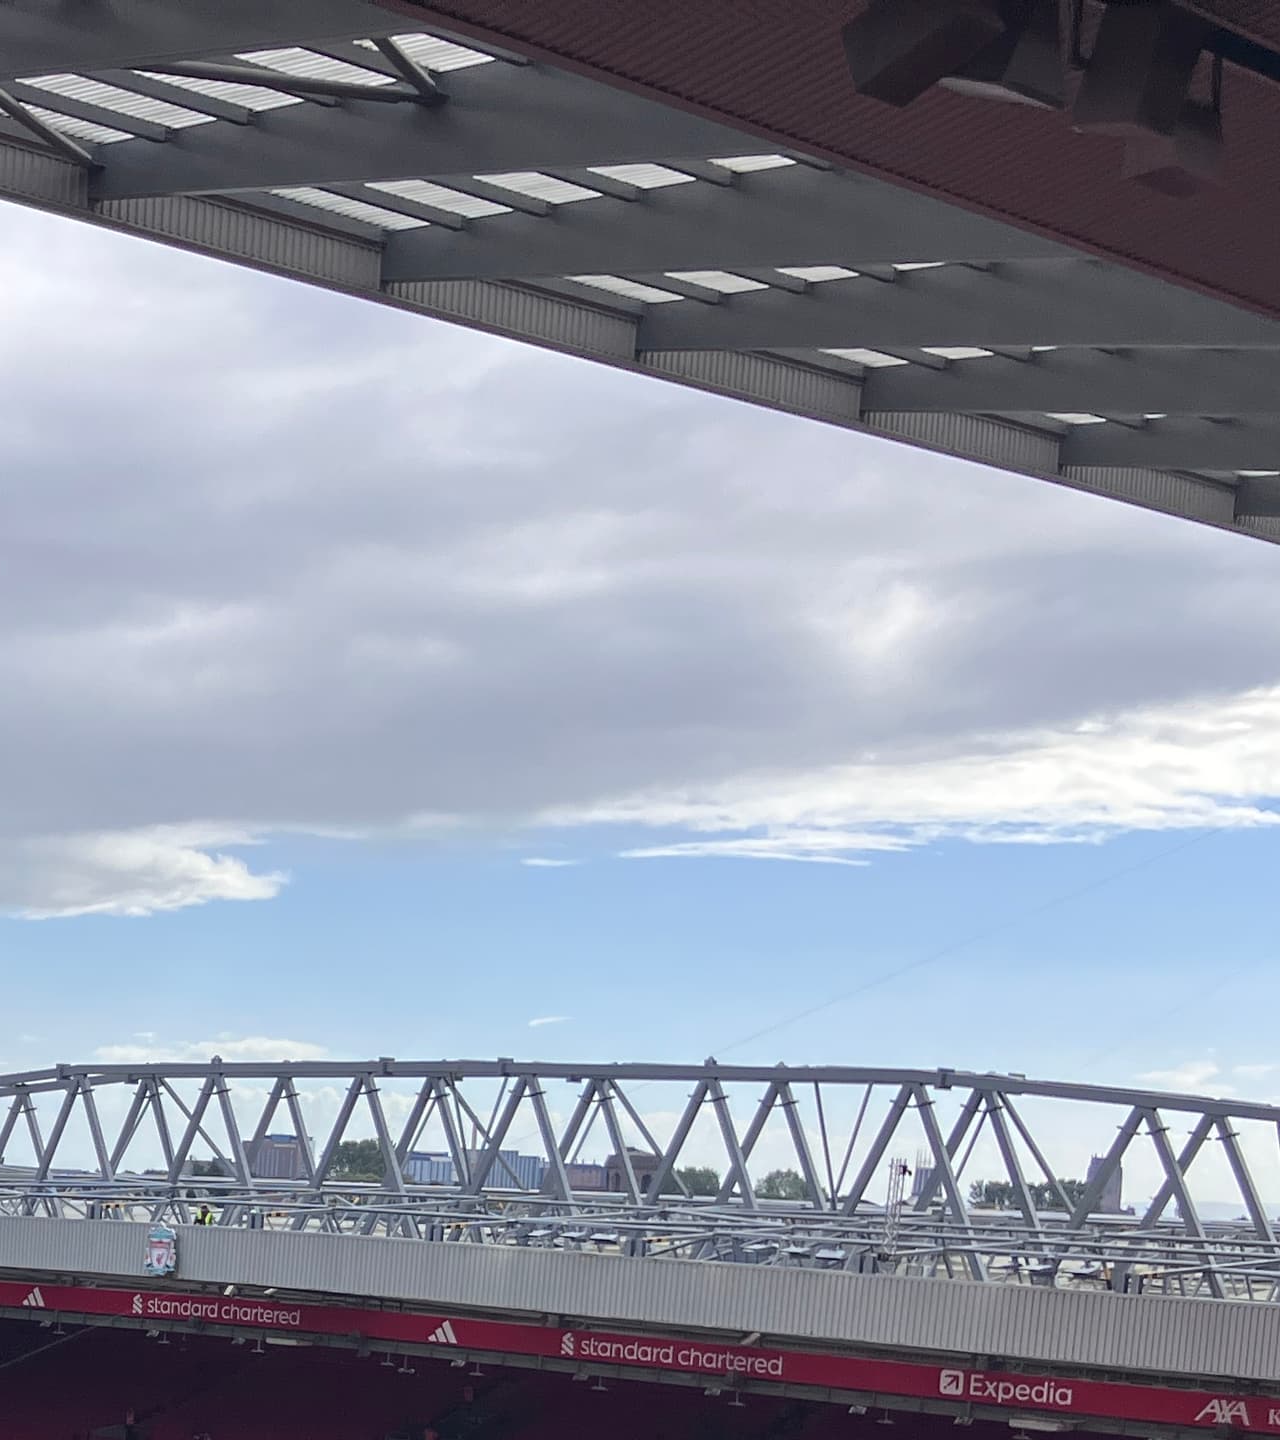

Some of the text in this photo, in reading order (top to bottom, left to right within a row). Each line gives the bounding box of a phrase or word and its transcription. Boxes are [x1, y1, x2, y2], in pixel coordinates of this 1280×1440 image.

[147, 1296, 301, 1326] standard chartered
[580, 1339, 783, 1376] standard chartered
[969, 1374, 1072, 1406] Expedia
[1194, 1399, 1250, 1426] AXA
